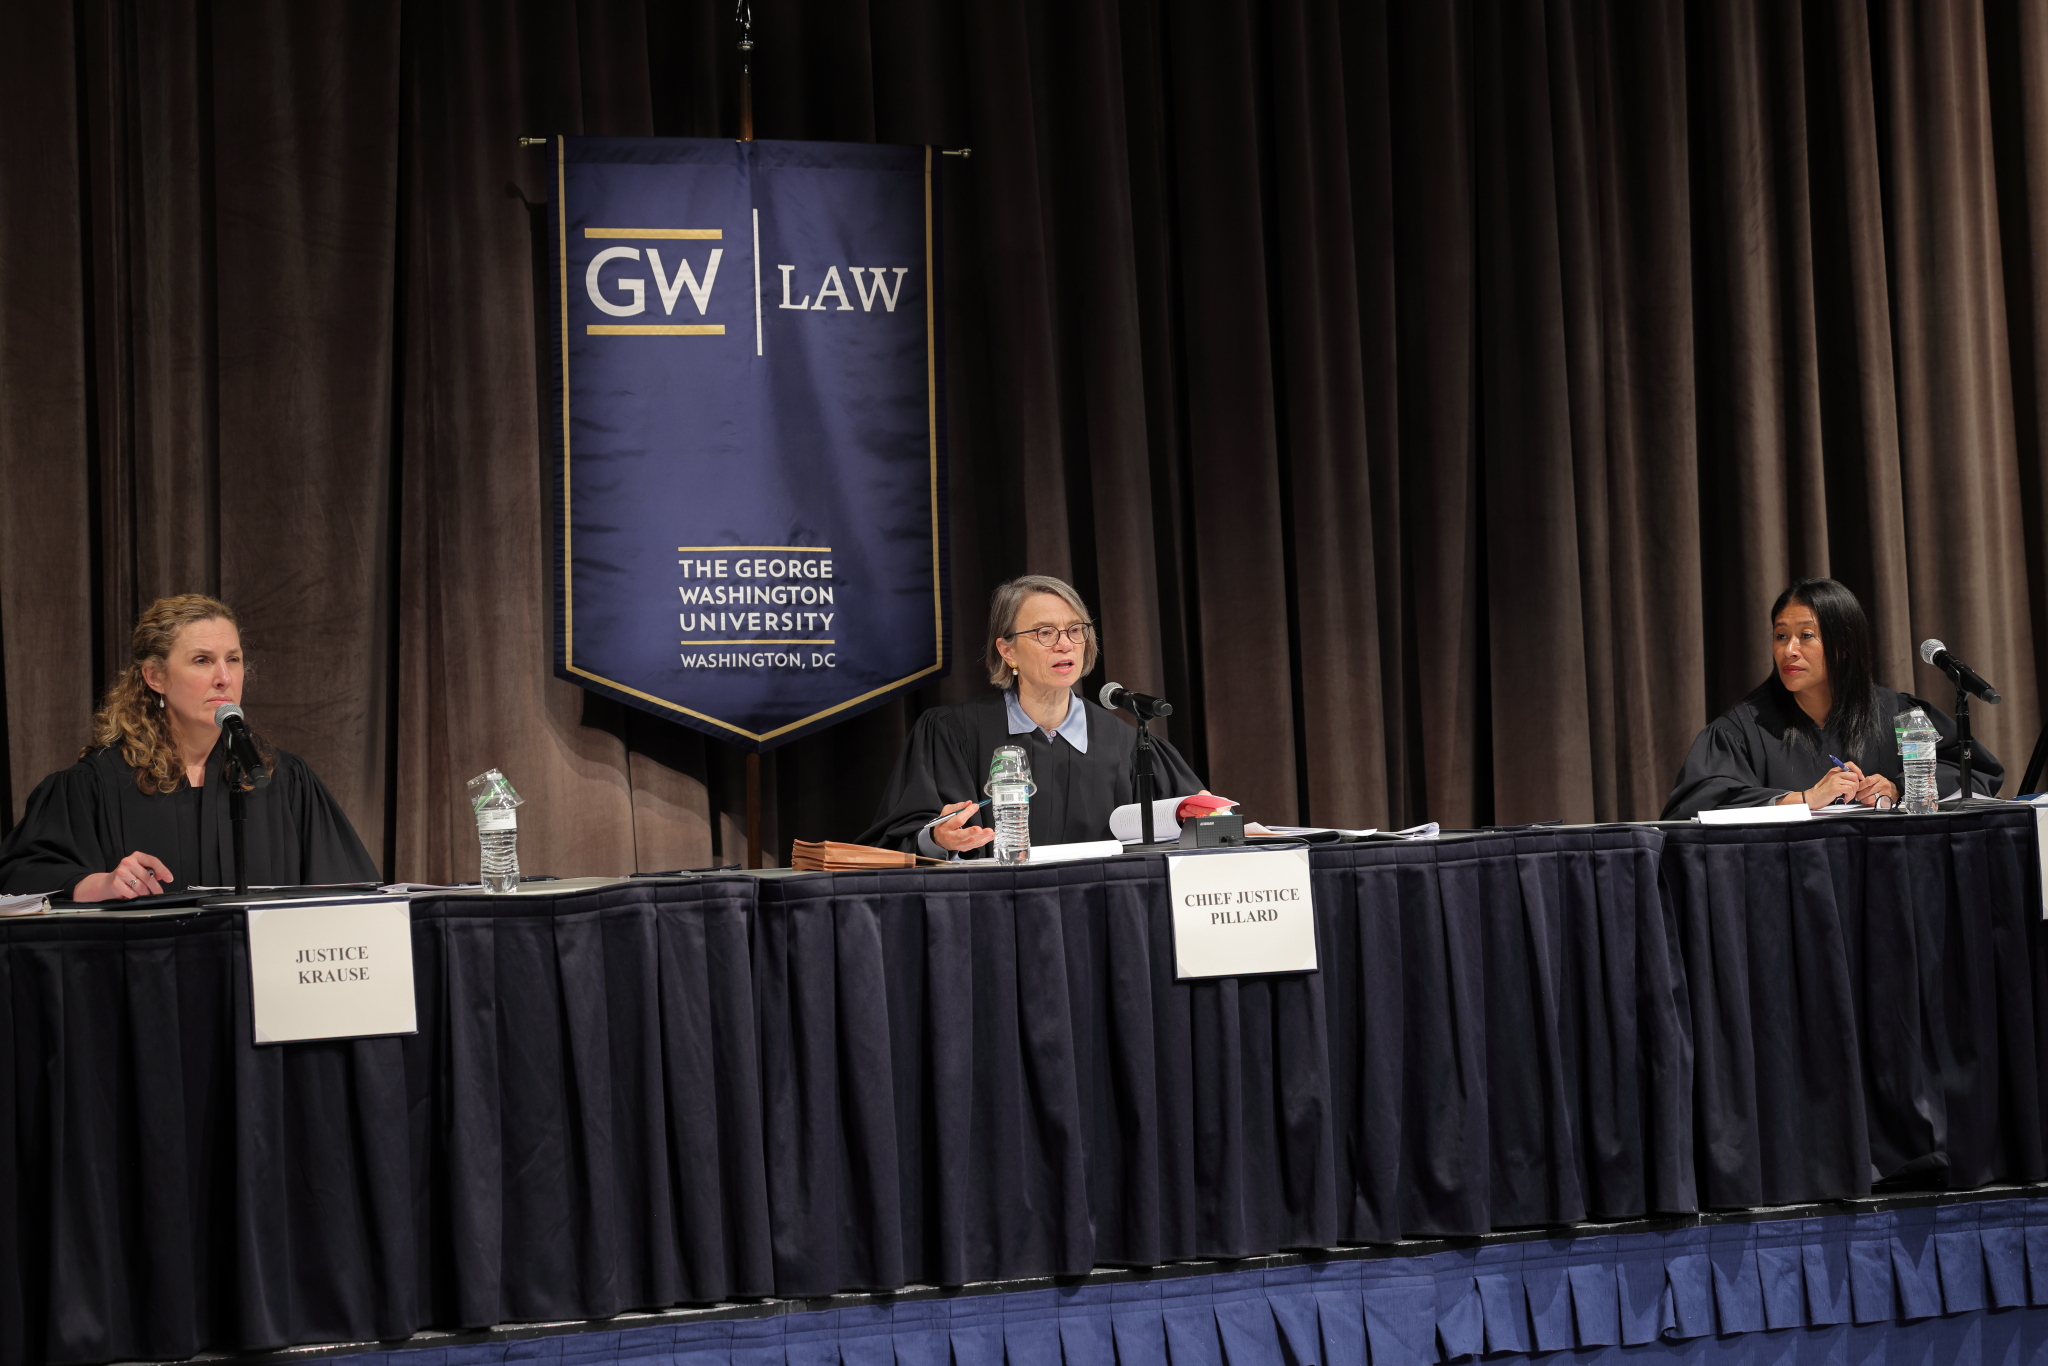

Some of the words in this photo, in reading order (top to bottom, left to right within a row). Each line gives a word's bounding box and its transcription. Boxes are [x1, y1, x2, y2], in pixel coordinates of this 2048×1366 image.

[585, 246, 724, 318] GW
[777, 264, 909, 313] LAW
[678, 559, 729, 579] THE
[734, 558, 833, 579] GEORGE
[678, 585, 835, 605] WASHINGTON
[679, 612, 835, 632] UNIVERSITY
[680, 652, 807, 670] WASHINGTON,
[811, 652, 836, 668] DC
[1184, 892, 1233, 907] CHIEF
[1236, 888, 1300, 904] JUSTICE
[1210, 909, 1279, 925] PILLARD
[295, 946, 369, 964] JUSTICE
[297, 967, 370, 985] KRAUSE
